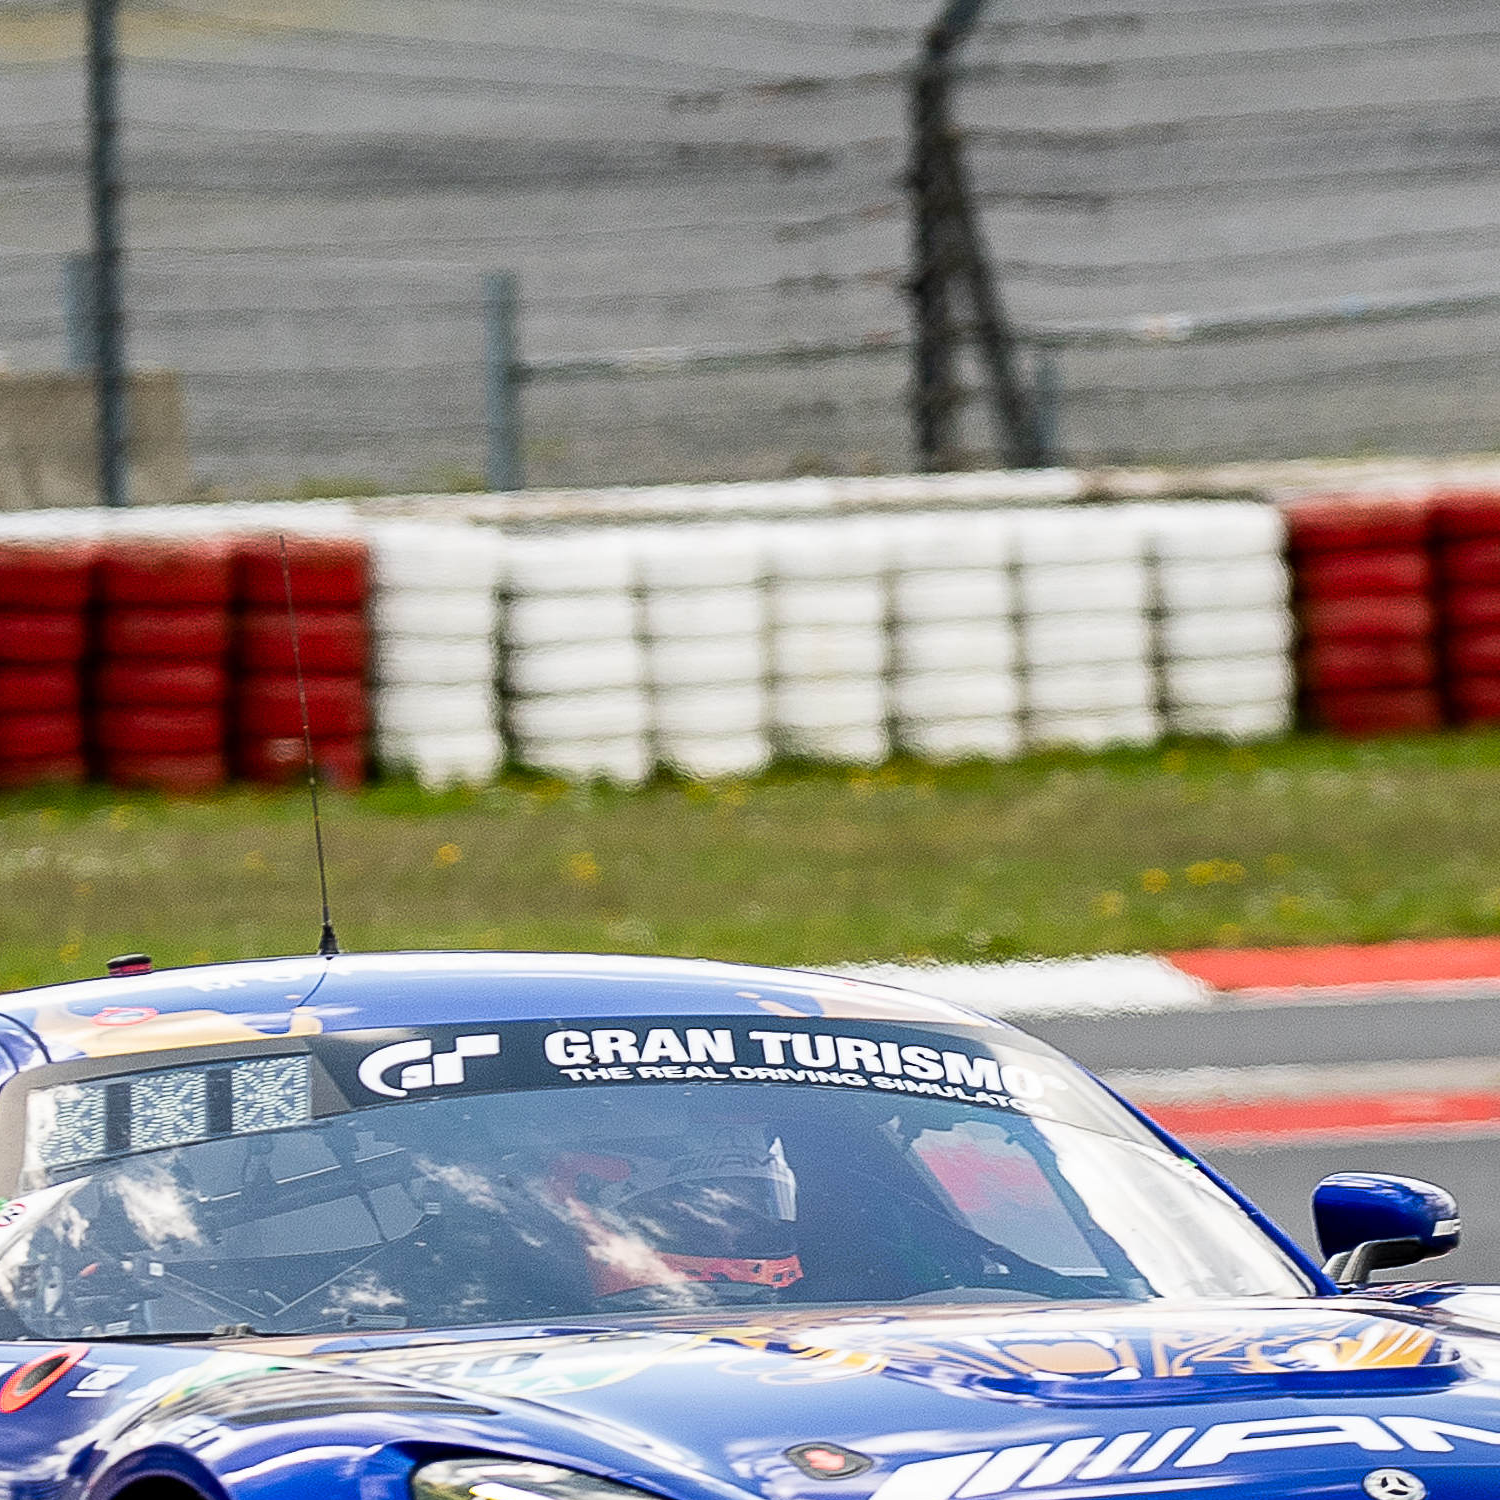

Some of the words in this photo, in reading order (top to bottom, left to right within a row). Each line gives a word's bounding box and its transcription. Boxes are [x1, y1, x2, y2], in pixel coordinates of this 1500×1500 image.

[544, 1027, 736, 1067] GRAN
[748, 1030, 1047, 1100] TURISMO
[559, 1066, 635, 1082] THE
[636, 1065, 730, 1080] REAL
[729, 1065, 869, 1088] DRIVING
